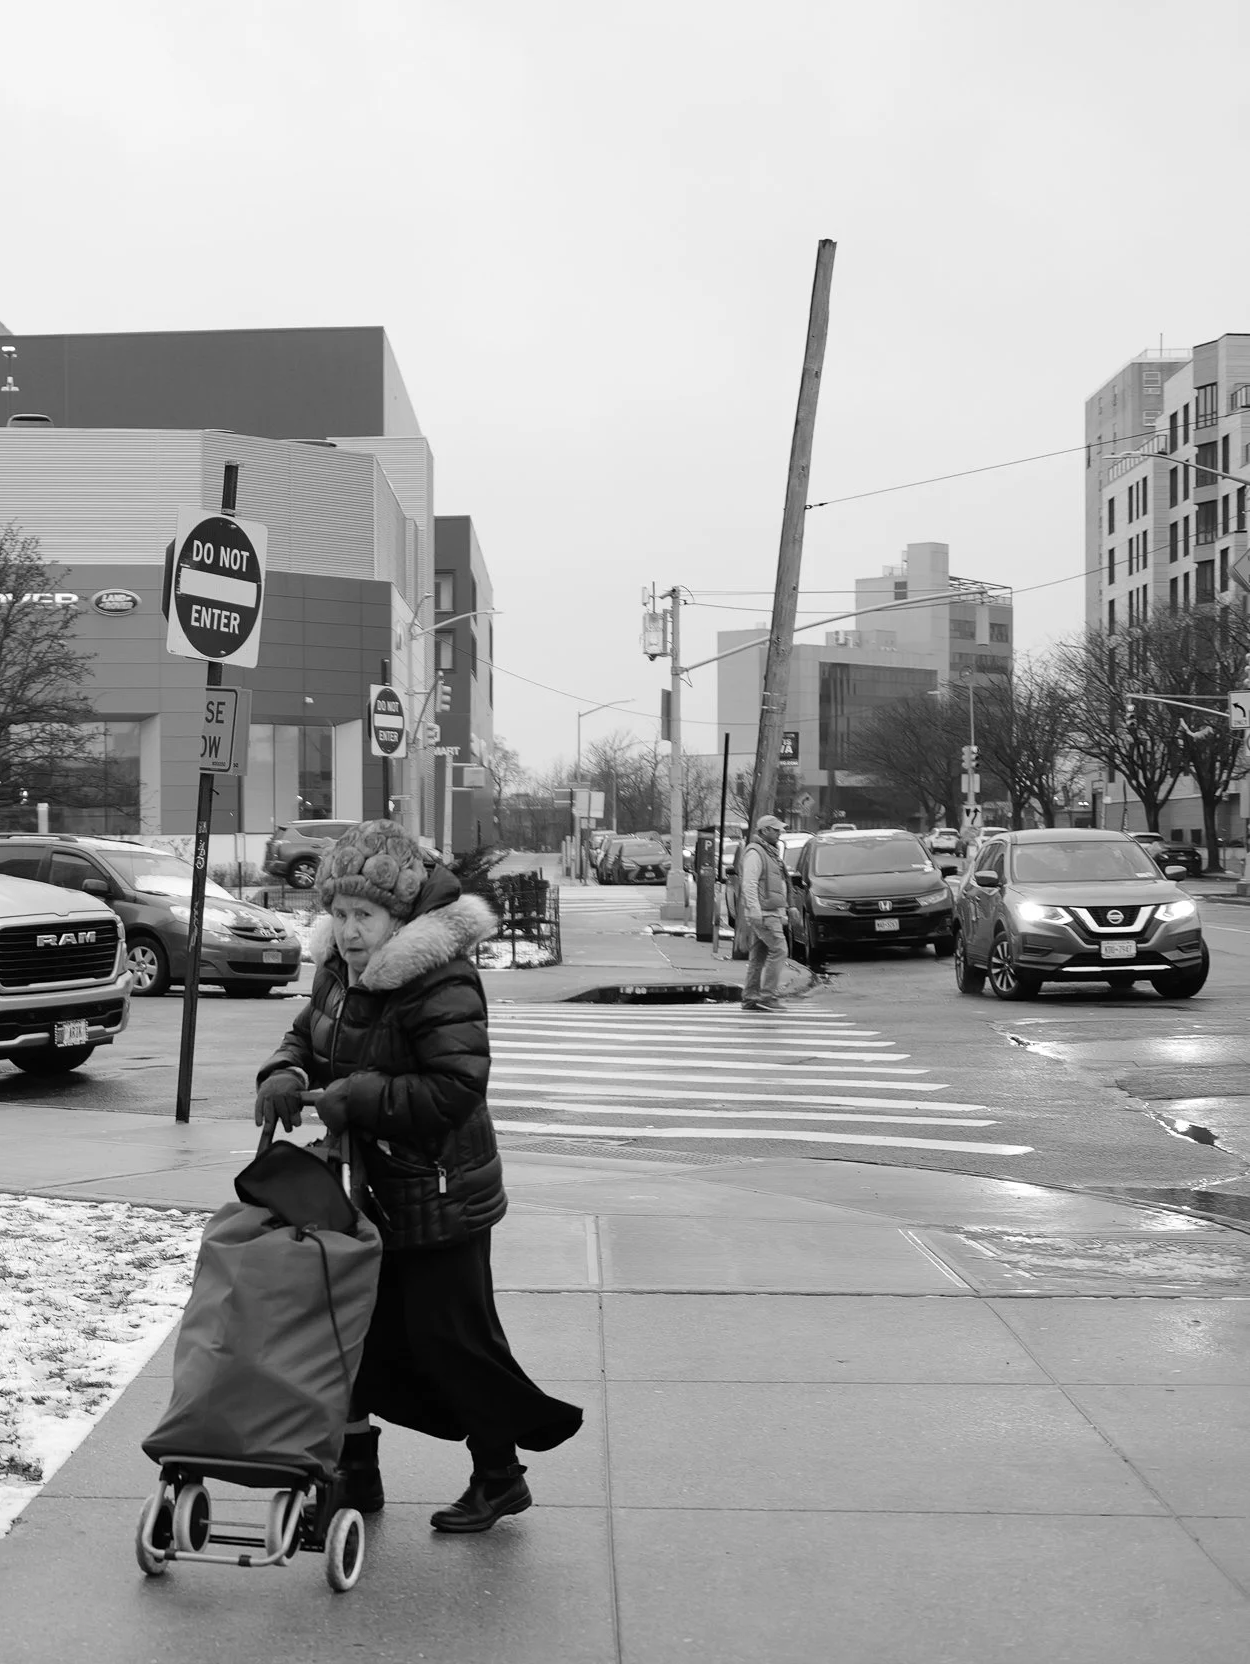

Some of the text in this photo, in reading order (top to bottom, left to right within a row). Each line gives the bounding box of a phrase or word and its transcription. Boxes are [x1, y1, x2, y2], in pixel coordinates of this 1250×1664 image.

[192, 539, 250, 572] DO NOT
[101, 594, 127, 602] LAND
[190, 604, 241, 634] ENTER
[376, 699, 400, 713] DO NOT
[378, 729, 399, 742] ENTER
[705, 839, 713, 851] P
[36, 931, 96, 947] RAM
